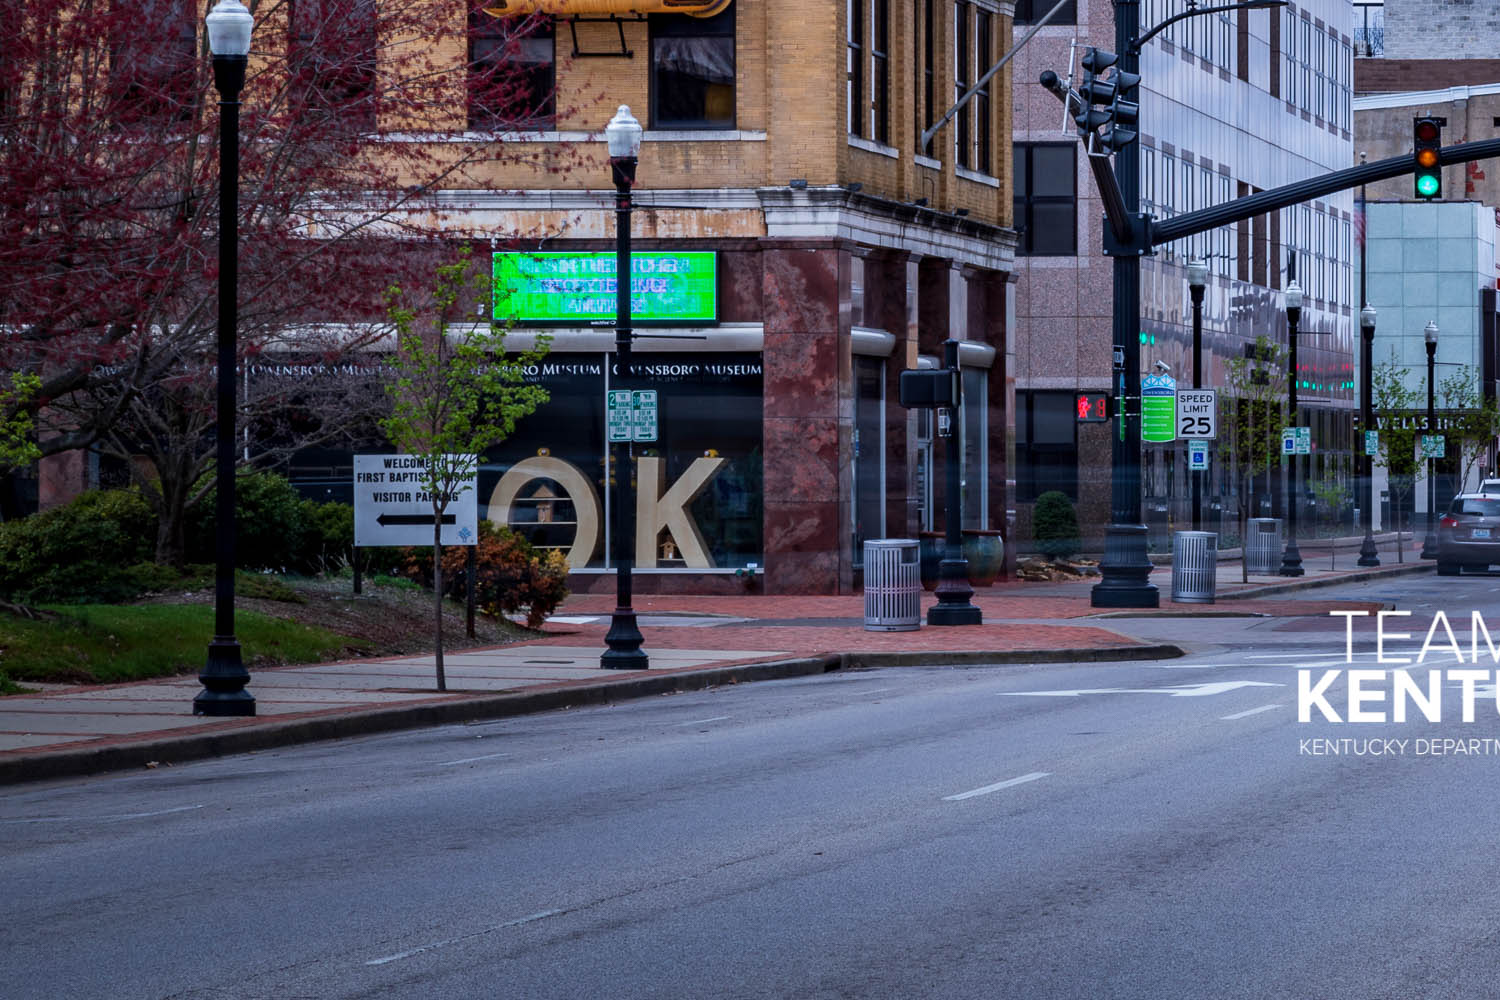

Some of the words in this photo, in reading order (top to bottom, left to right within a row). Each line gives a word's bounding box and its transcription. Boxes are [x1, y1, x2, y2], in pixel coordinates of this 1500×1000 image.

[612, 364, 700, 376] NSBORO
[1180, 395, 1212, 403] SPEED
[1183, 405, 1209, 413] LIMIT
[1181, 417, 1211, 434] 25
[1376, 416, 1429, 430] WELLS
[383, 458, 431, 469] WELCOME
[357, 472, 385, 483] FIRST
[389, 472, 430, 482] BAPTIST
[372, 491, 411, 503] VISITOR
[415, 491, 459, 503] PARG
